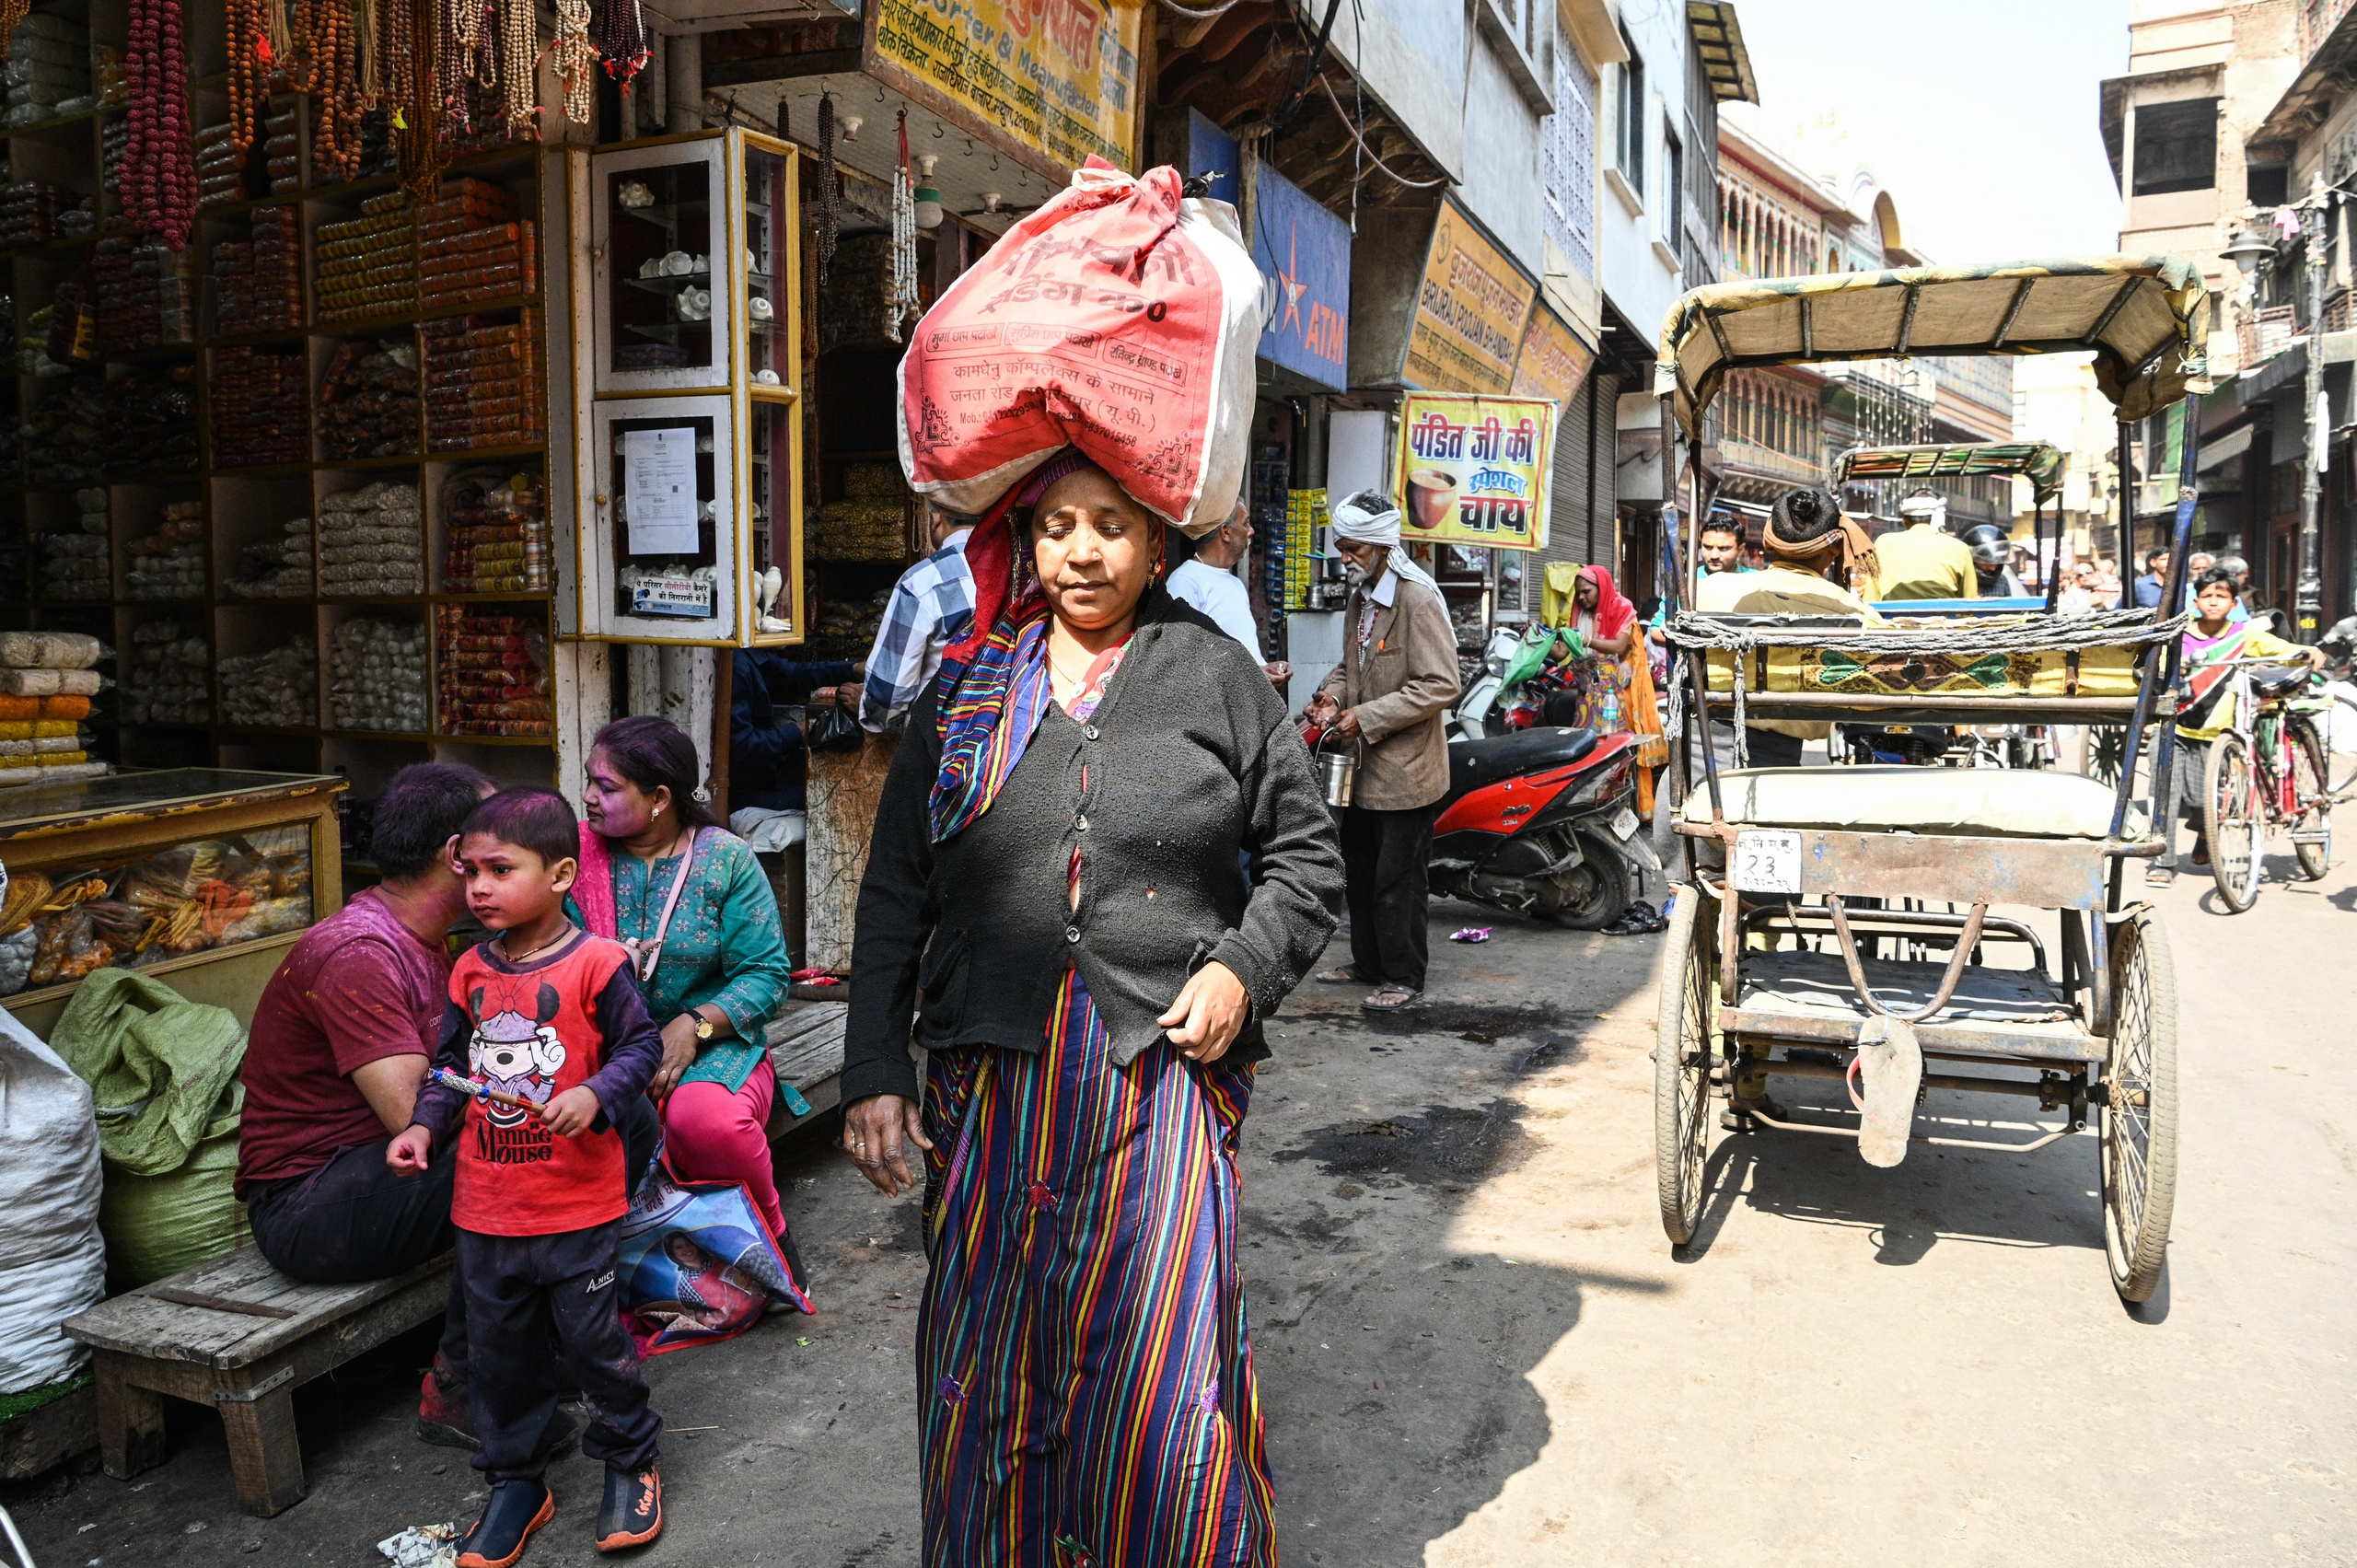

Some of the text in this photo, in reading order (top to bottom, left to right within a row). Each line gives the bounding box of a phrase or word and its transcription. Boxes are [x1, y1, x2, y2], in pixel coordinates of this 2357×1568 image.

[877, 19, 897, 52] थोक
[897, 32, 929, 70] विक्रेता
[942, 25, 955, 56] की
[998, 31, 1014, 62] &
[952, 329, 968, 342] छाप
[1305, 300, 1345, 366] ATM
[1421, 277, 1455, 327] BRIJRAJ
[1482, 324, 1515, 367] BHANDAR
[954, 359, 1001, 381] कामधेनु
[1086, 370, 1104, 389] के
[949, 389, 986, 402] जनता
[959, 412, 981, 424] Mob.:
[1411, 411, 1538, 464] पंडित जी की
[1469, 466, 1527, 497] स्पेशल
[1459, 495, 1532, 535] चाय
[658, 590, 667, 600] की
[668, 591, 693, 602] निगरानी
[702, 592, 708, 604] है
[664, 580, 691, 591] सीसीटीवी
[692, 581, 708, 592] कैमरे
